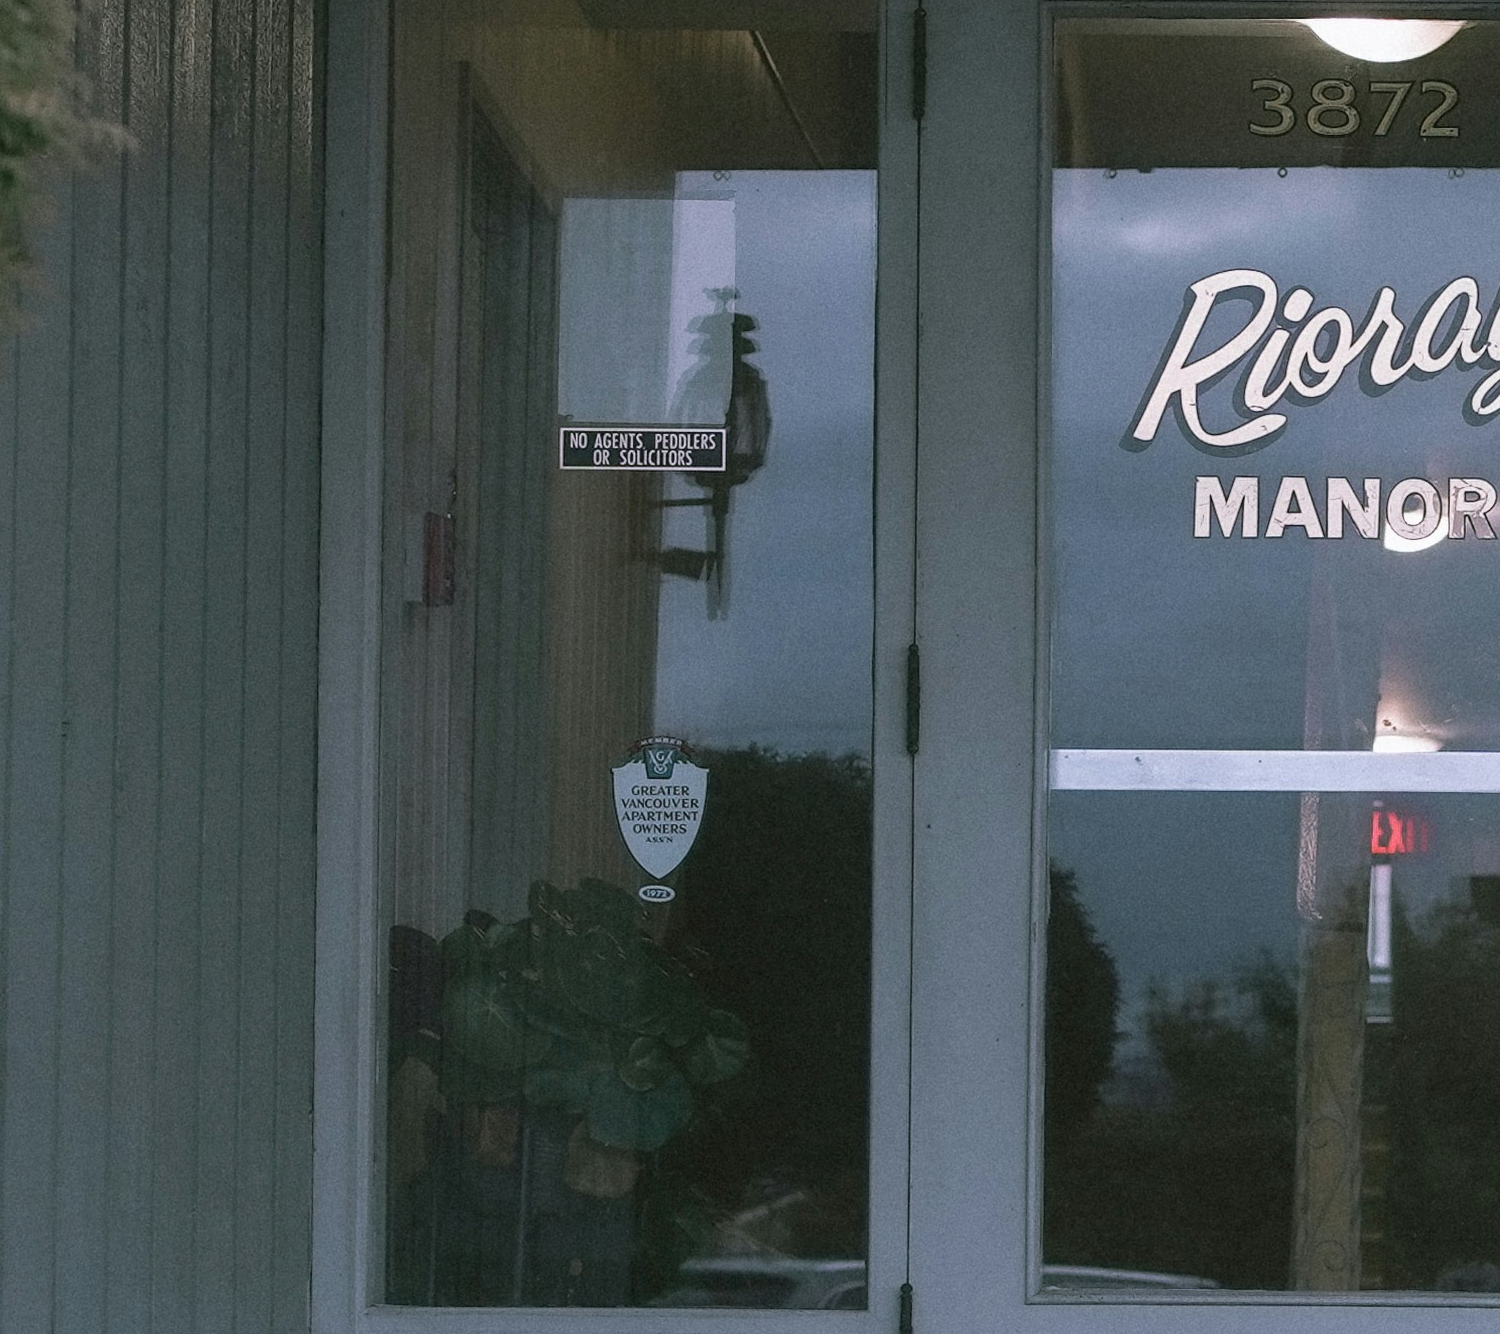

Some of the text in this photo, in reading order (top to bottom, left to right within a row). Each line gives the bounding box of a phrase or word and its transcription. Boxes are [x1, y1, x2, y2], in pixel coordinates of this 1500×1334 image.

[1249, 78, 1460, 139] 3872
[570, 432, 588, 449] NO
[655, 433, 716, 450] PEDDLERS
[593, 449, 693, 466] OR SOLICITORS
[1193, 475, 1498, 540] MANOR
[631, 785, 690, 796] GREATER
[621, 798, 699, 809] VANCOUVER
[621, 811, 699, 821] APARTMENT
[633, 823, 687, 835] OWNERS
